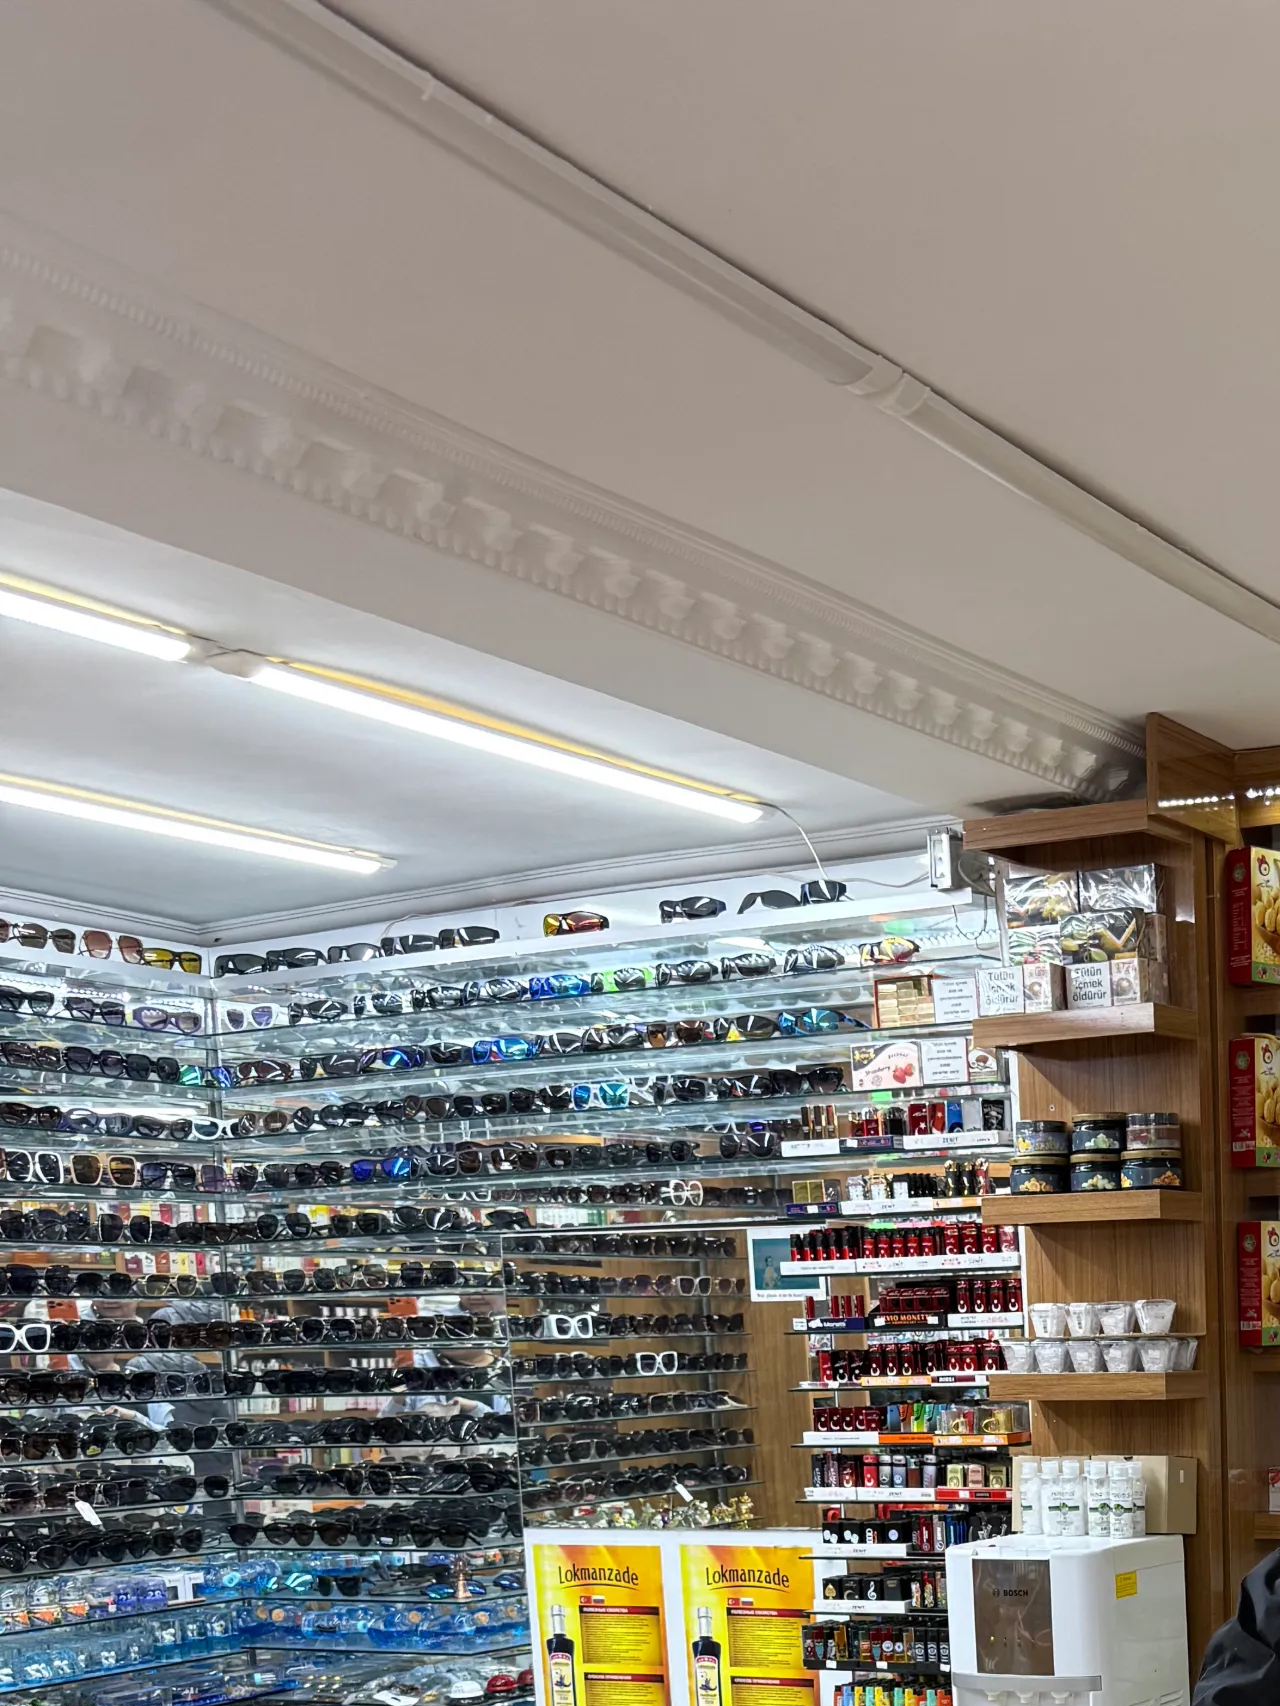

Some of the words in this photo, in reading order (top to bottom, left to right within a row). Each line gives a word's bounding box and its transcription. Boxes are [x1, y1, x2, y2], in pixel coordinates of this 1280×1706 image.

[558, 1563, 638, 1587] Lokmanzade
[705, 1564, 790, 1588] Lokmanzade
[1003, 1589, 1029, 1597] BOSCH
